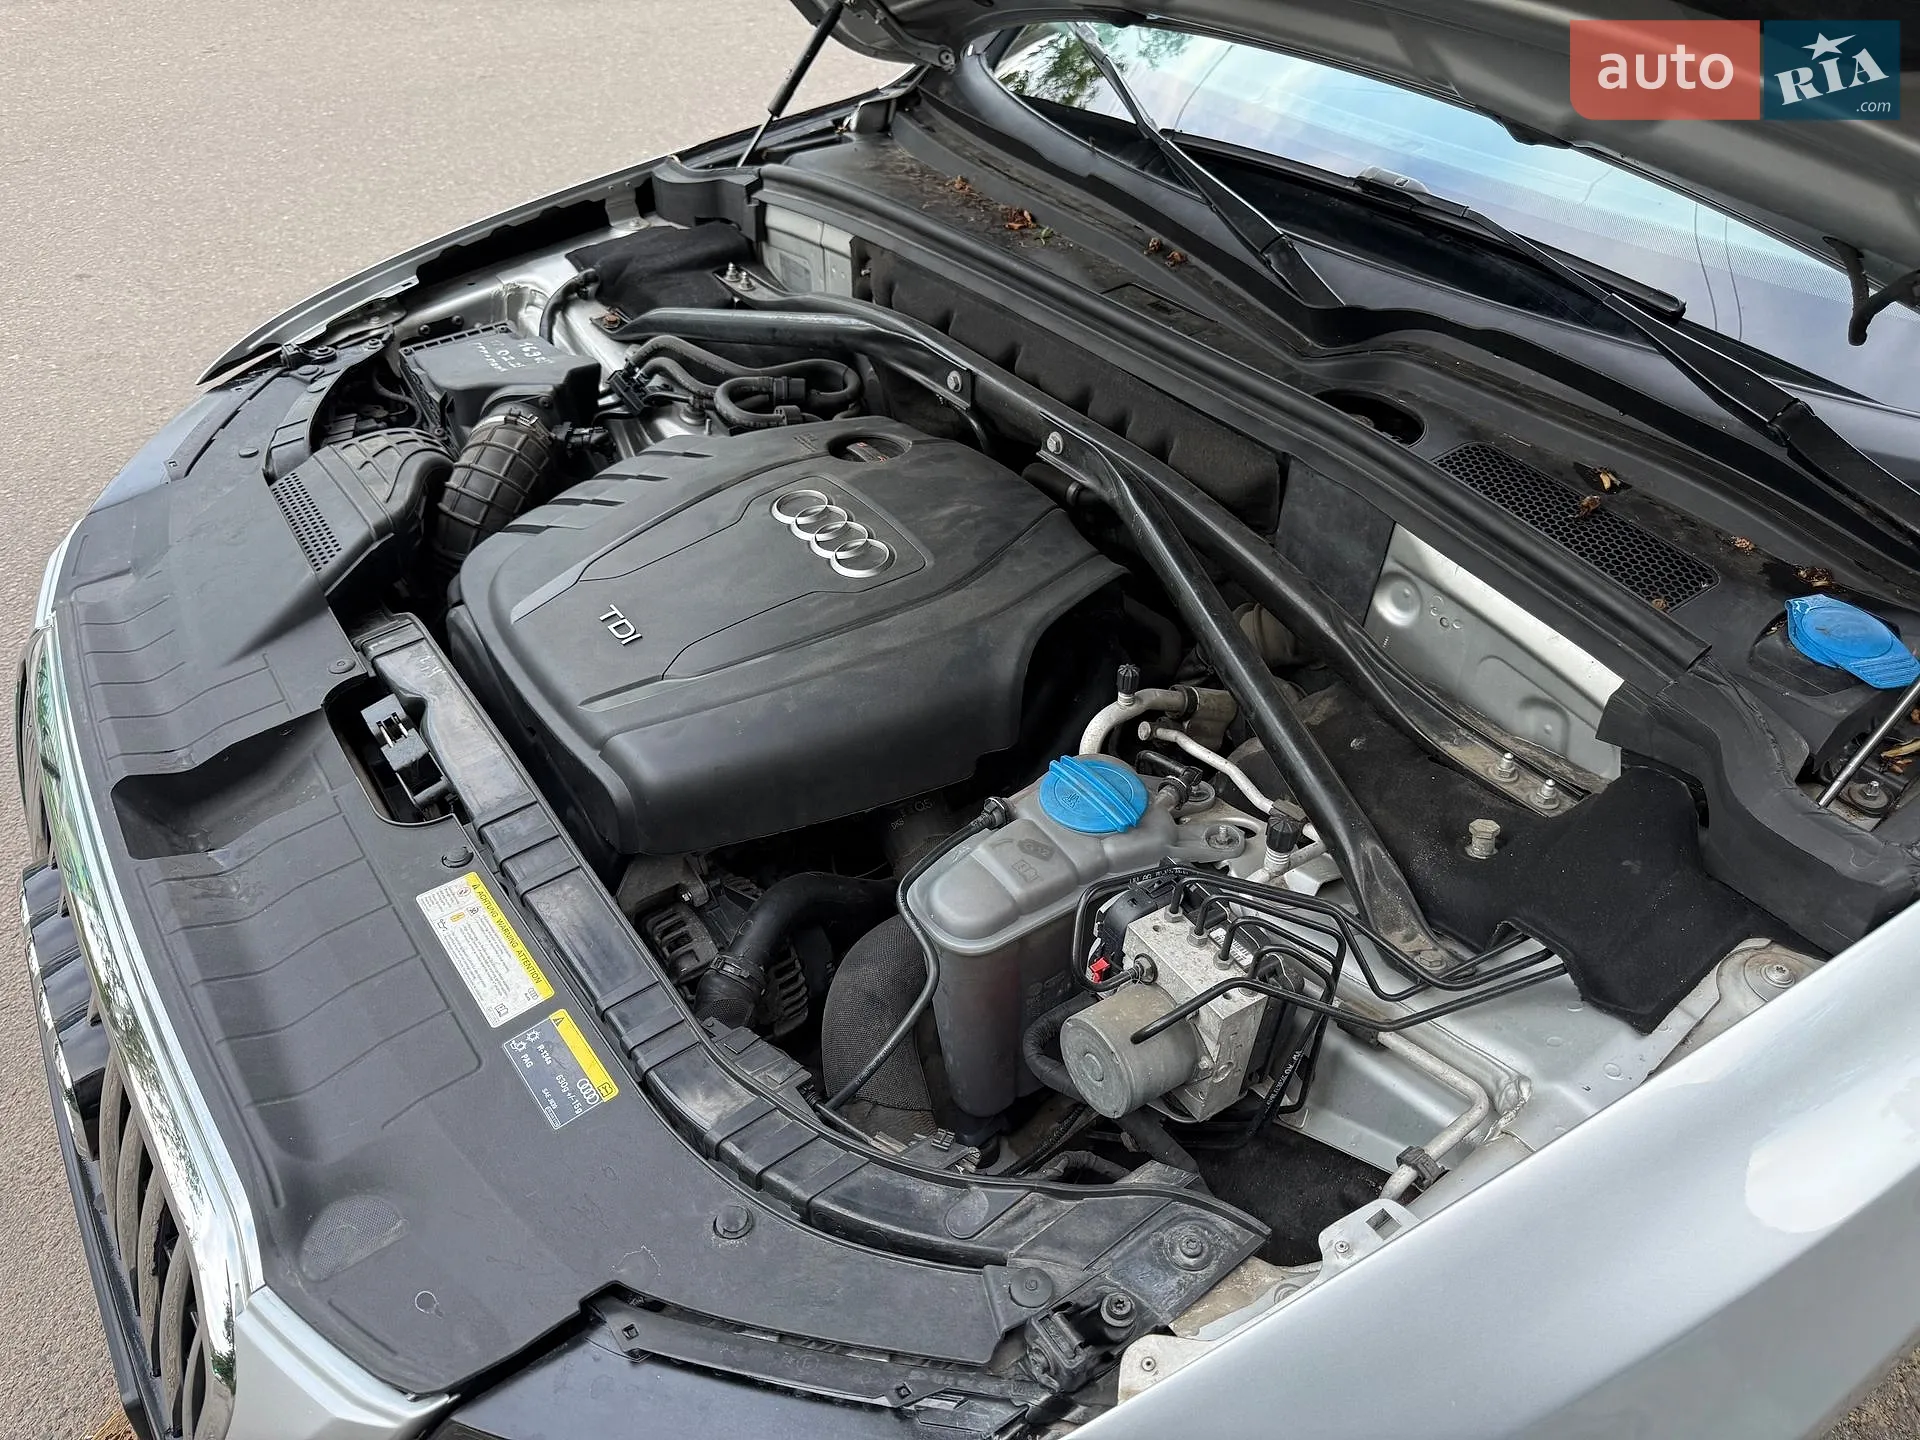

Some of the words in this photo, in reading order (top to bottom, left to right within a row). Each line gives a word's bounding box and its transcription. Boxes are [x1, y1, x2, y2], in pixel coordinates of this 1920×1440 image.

[599, 603, 643, 645] TDI
[477, 891, 499, 918] ACHTUNG
[496, 918, 519, 949] WARNING
[516, 949, 543, 984] ATTENTION
[521, 1053, 534, 1068] PAG
